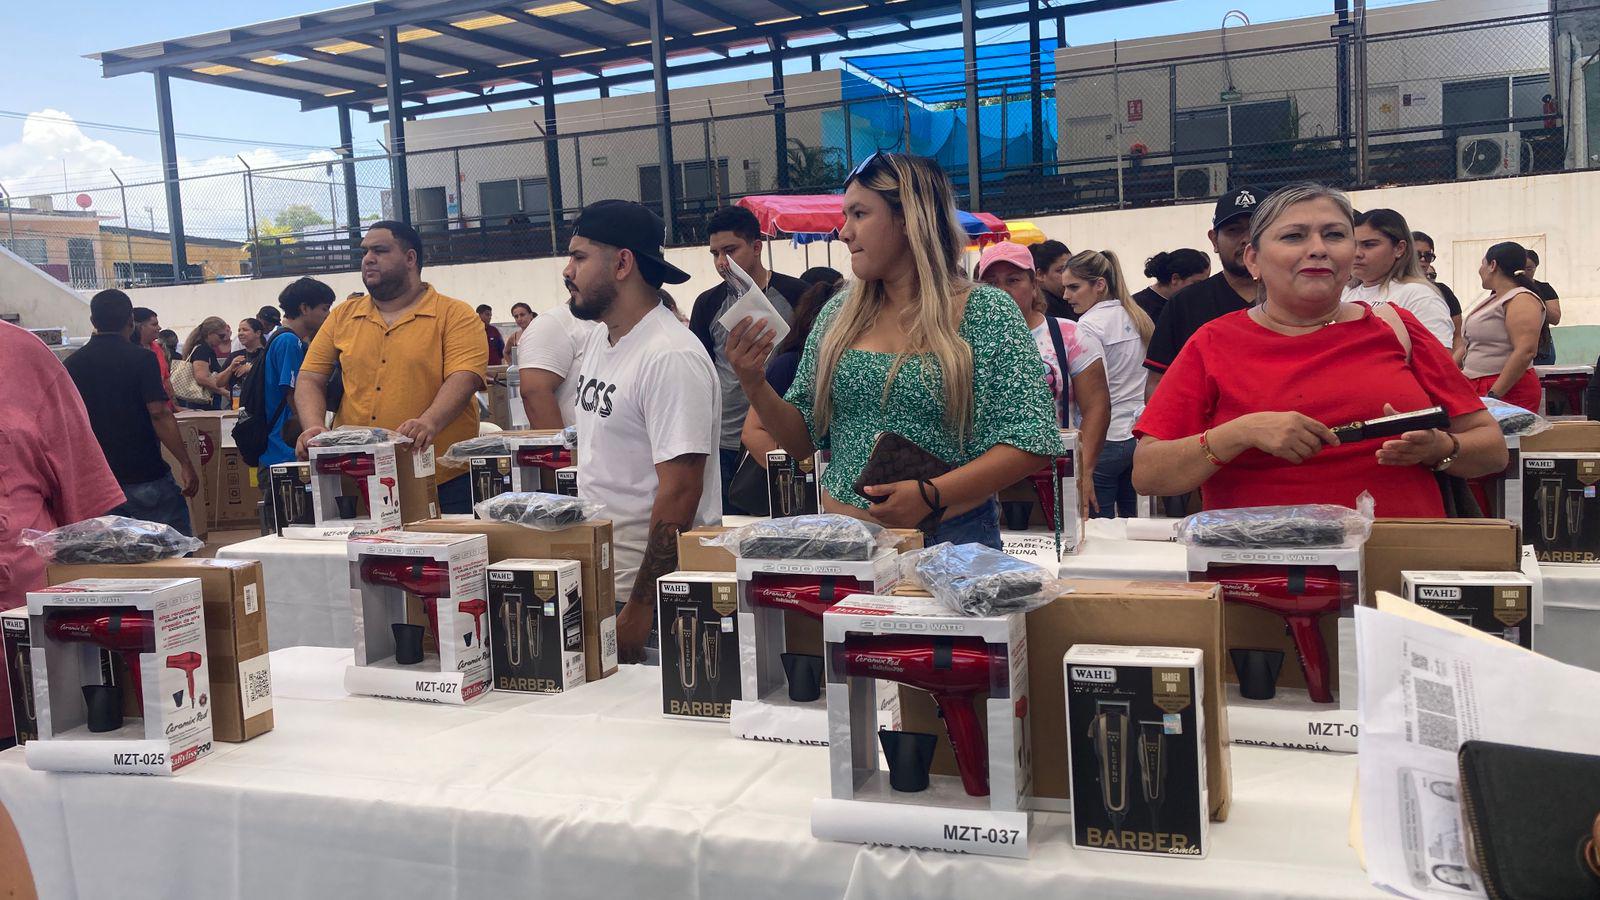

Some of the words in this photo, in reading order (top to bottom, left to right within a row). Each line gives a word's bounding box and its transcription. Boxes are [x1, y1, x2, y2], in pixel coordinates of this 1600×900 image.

[1221, 552, 1285, 561] 2000
[1287, 553, 1320, 561] WATTS
[763, 563, 813, 573] 2000
[815, 565, 842, 573] WATTS
[663, 584, 687, 592] WAHL
[763, 588, 786, 598] Ceramix
[1423, 588, 1457, 598] WAHL
[861, 619, 928, 631] 2000
[930, 623, 964, 632] WATTS
[855, 654, 887, 664] Ceramix
[886, 656, 901, 667] Red
[1074, 669, 1112, 680] WAHL
[415, 681, 458, 693] MZT-027
[500, 676, 556, 691] BARBER
[165, 716, 196, 735] Ceramix
[196, 709, 209, 722] Red
[1308, 722, 1359, 737] MZT-0
[113, 753, 165, 765] MZT-025
[943, 824, 1020, 845] MZT-037
[1087, 827, 1188, 852] BARBER
[1168, 844, 1201, 855] combo
